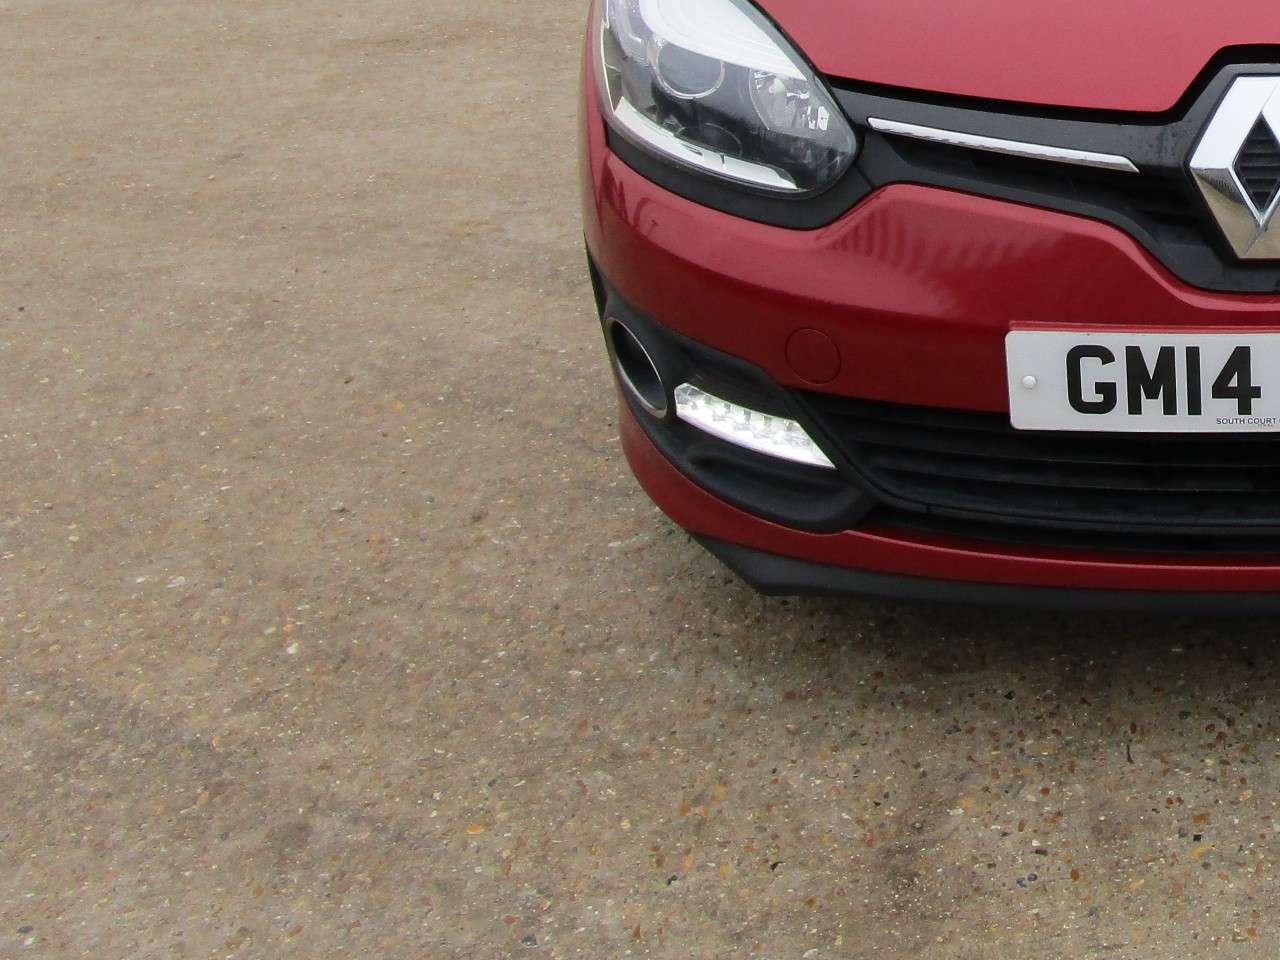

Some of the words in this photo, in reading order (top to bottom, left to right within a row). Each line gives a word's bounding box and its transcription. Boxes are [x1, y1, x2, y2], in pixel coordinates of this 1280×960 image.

[1066, 345, 1261, 415] GM14
[1216, 417, 1245, 425] SOUTH
[1247, 417, 1277, 425] COURT
